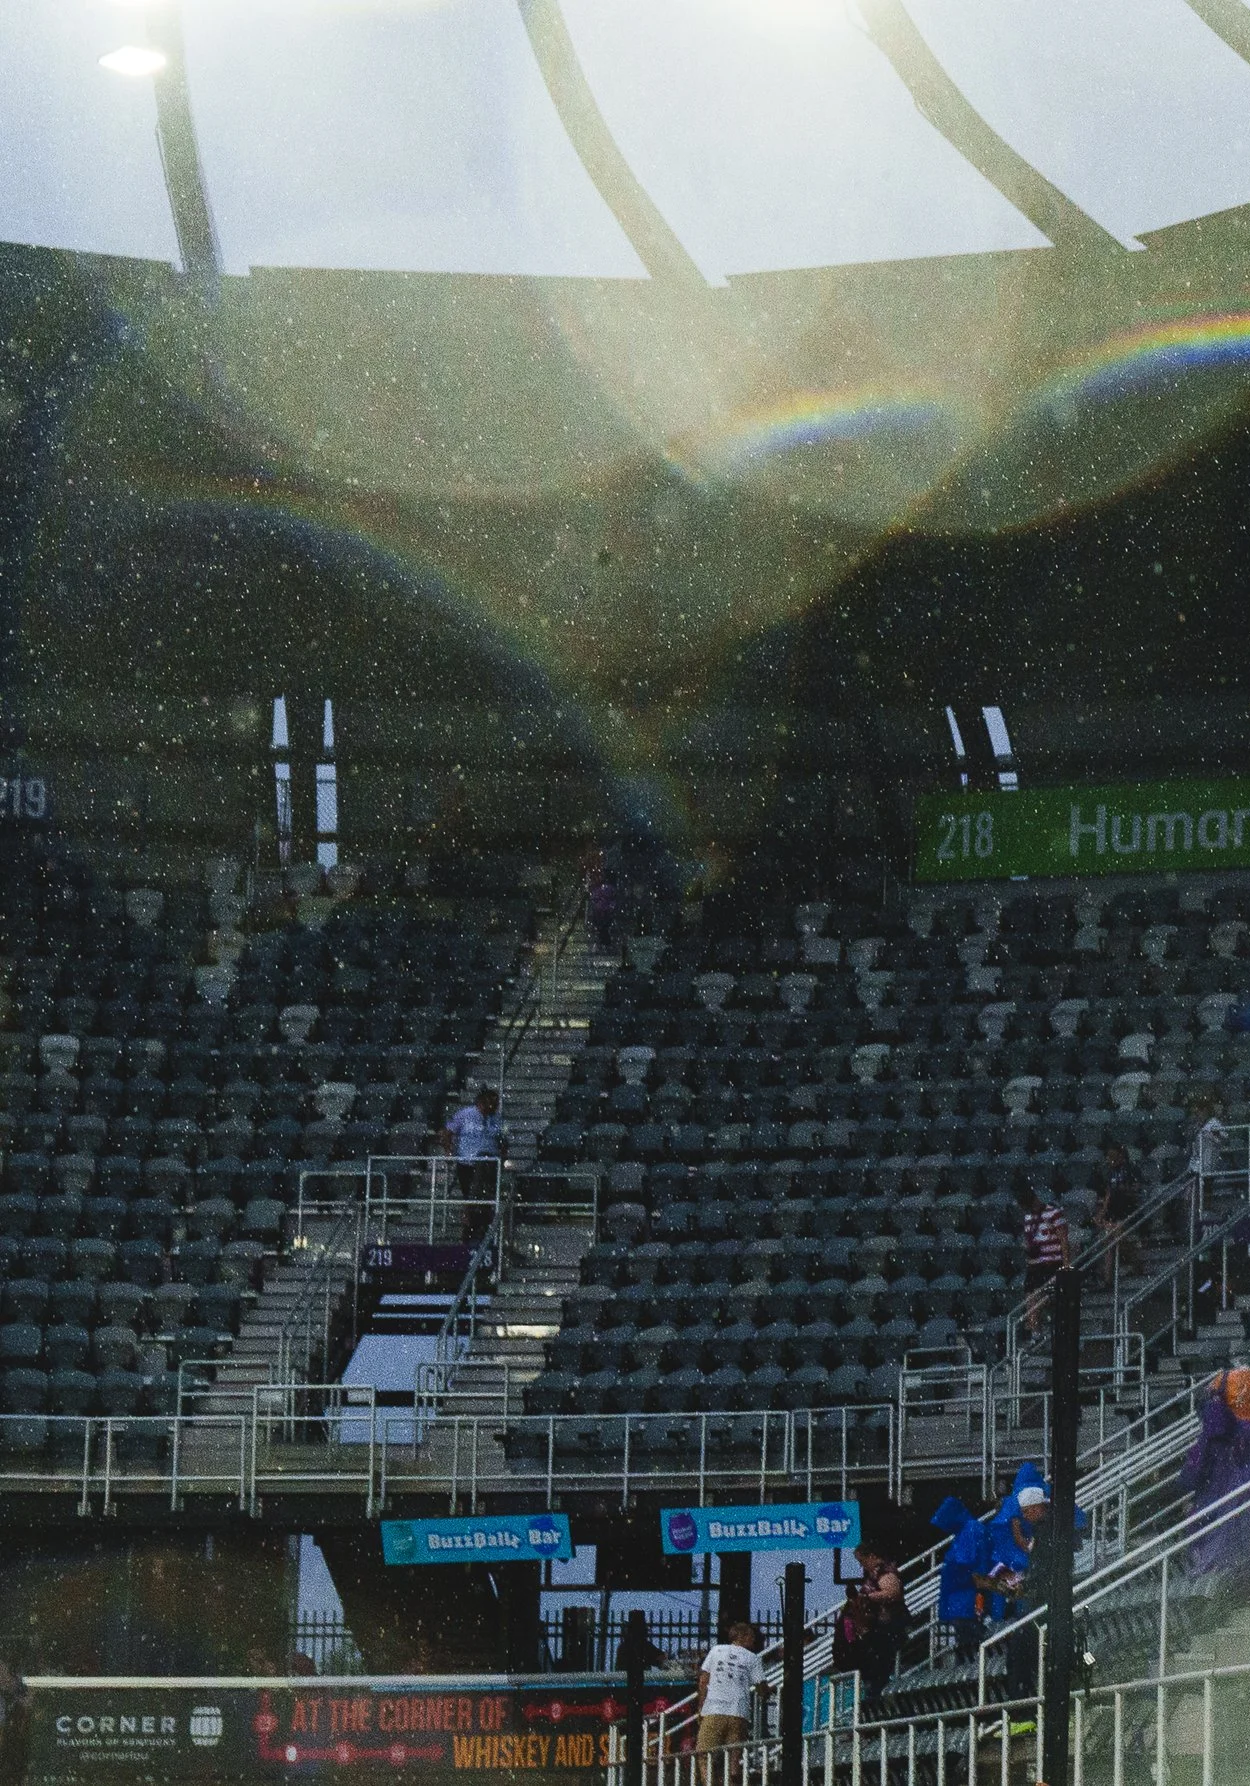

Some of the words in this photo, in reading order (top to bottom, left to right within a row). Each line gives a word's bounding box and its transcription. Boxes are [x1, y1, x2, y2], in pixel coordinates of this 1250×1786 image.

[936, 811, 995, 860] 218
[368, 1248, 393, 1267] 219
[468, 1250, 493, 1267] 28
[816, 1516, 851, 1534] Bar
[528, 1528, 561, 1546] Bar
[55, 1715, 177, 1734] CORNER
[290, 1698, 321, 1734] AT
[329, 1698, 372, 1732] THE
[379, 1696, 473, 1732] CORNER
[480, 1697, 507, 1731] OF
[453, 1733, 550, 1769] WHISKEY
[555, 1734, 594, 1767] AND
